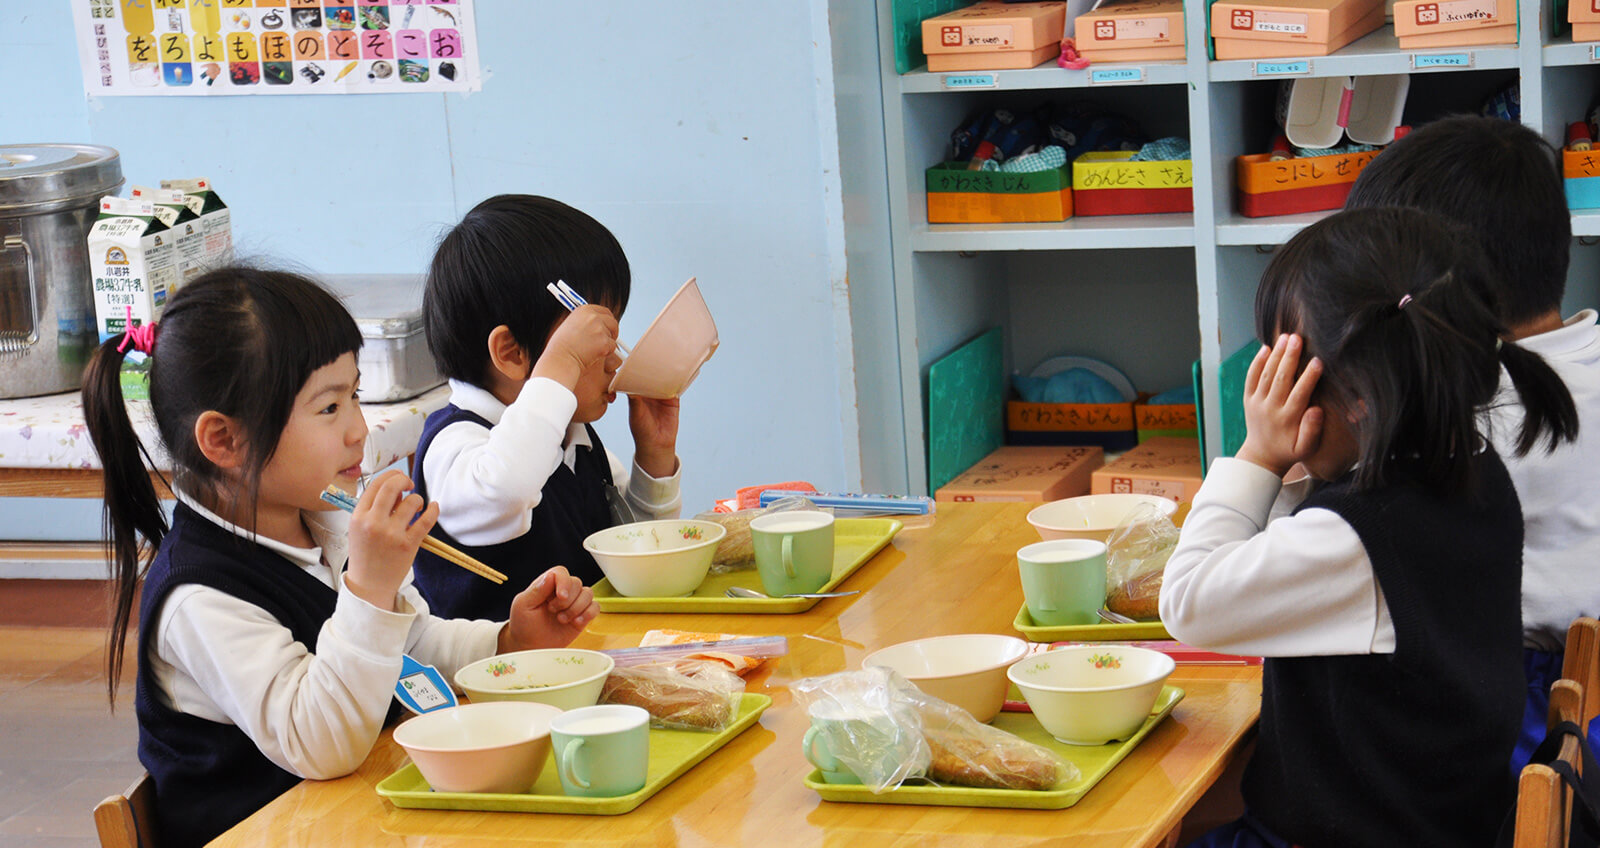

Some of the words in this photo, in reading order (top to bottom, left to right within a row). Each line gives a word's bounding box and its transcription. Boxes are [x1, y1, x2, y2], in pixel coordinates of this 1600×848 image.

[132, 36, 151, 61] を
[166, 36, 184, 60] ろ
[198, 36, 215, 60] よ
[232, 36, 249, 60] も
[264, 36, 284, 60] ほ
[297, 37, 319, 57] の
[333, 36, 350, 57] と
[366, 34, 385, 57] そ
[403, 35, 419, 56] こ
[434, 33, 454, 57] お
[941, 174, 993, 191] かわさき
[1003, 176, 1031, 190] じん
[1083, 168, 1146, 187] めんどーさ
[1159, 167, 1193, 185] さえ
[1275, 162, 1325, 183] こにし
